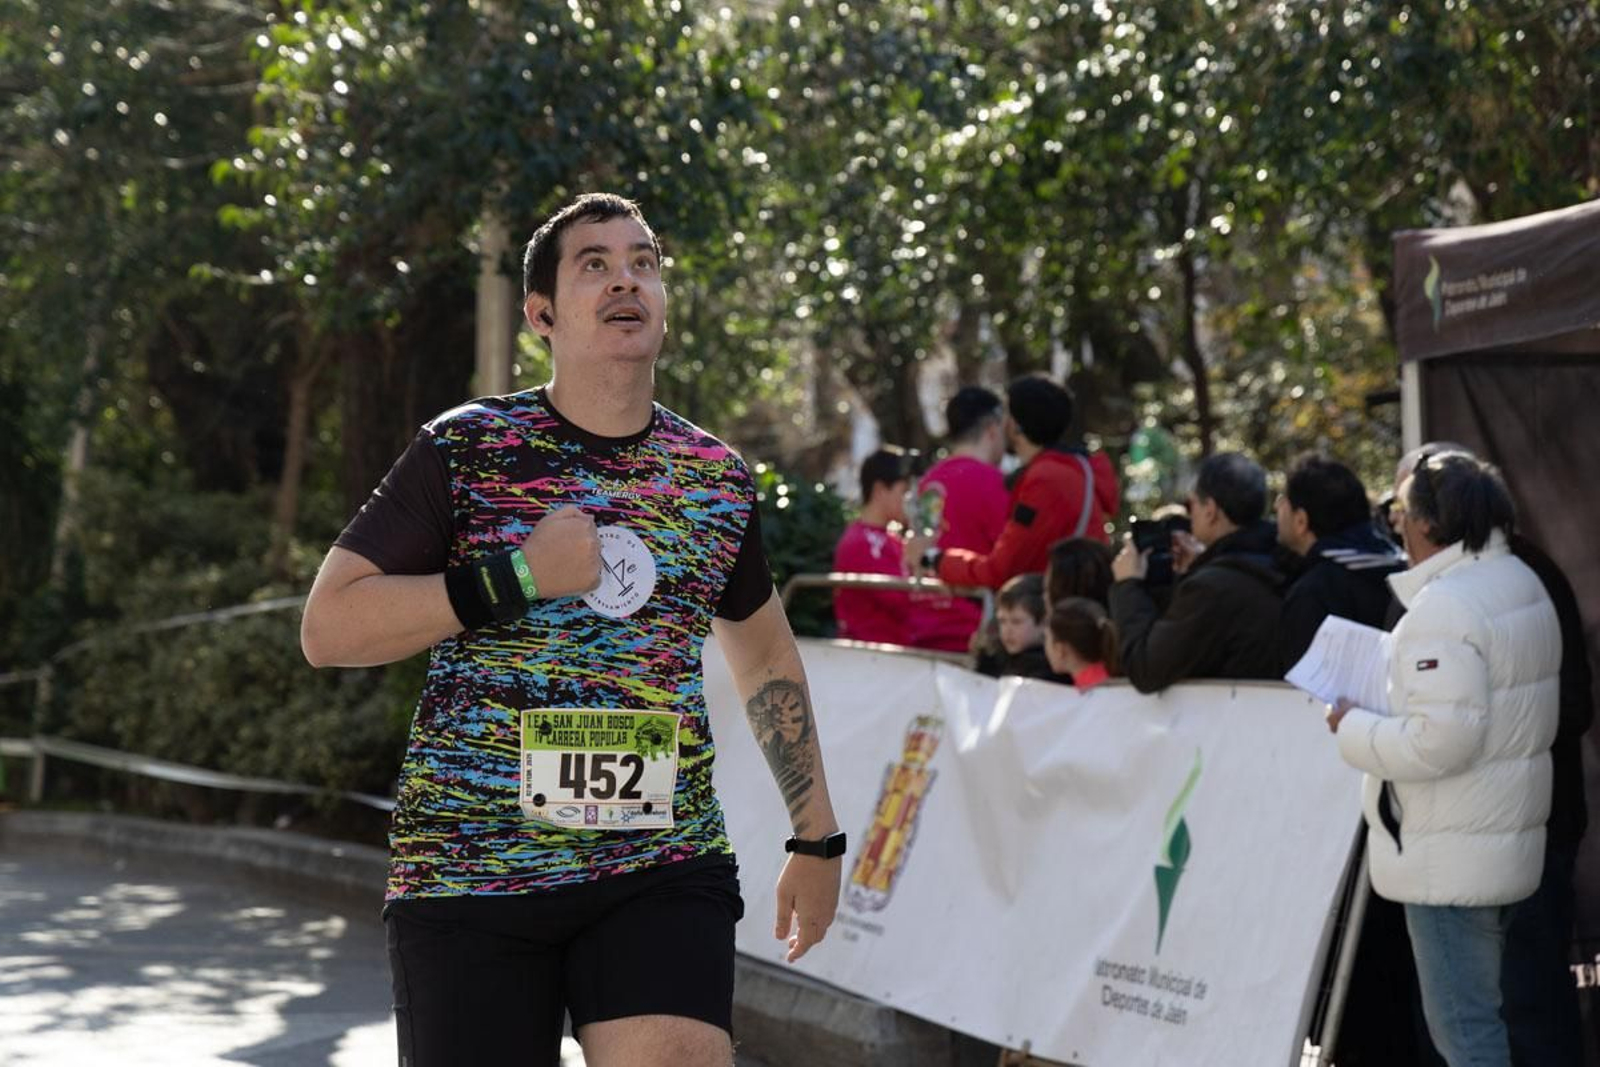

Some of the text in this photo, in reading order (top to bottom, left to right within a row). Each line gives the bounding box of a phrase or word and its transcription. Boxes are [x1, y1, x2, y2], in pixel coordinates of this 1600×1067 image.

[591, 487, 641, 499] TEAMERGY
[553, 714, 573, 729] SAN
[576, 714, 604, 729] JUAN
[607, 715, 635, 730] BOSCO
[588, 731, 628, 747] POPULAR
[559, 753, 645, 800] 452
